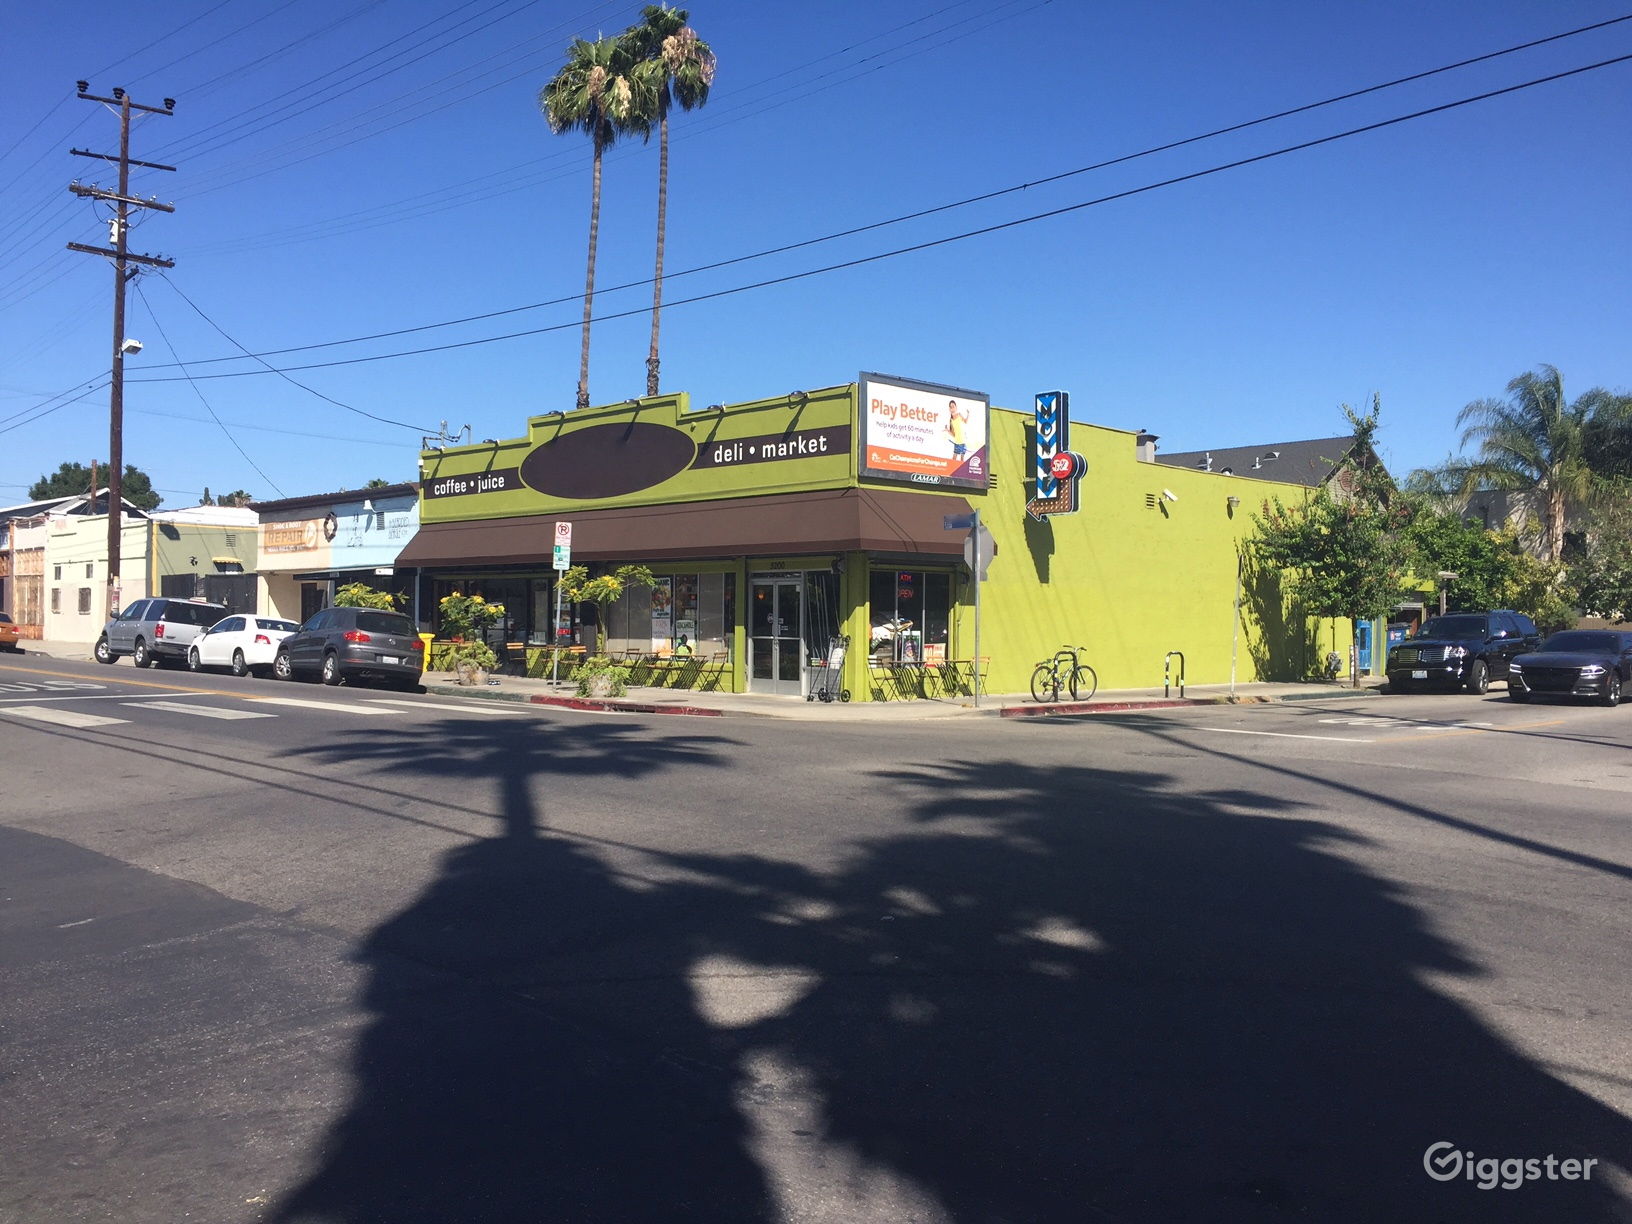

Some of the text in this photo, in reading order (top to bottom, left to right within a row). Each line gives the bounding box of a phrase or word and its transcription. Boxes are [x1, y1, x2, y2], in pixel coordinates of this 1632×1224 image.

[872, 399, 938, 423] Play Better
[714, 435, 827, 463] deli market
[434, 474, 505, 495] coffee juice
[913, 474, 939, 483] LAMAR
[269, 530, 303, 543] REPAIR
